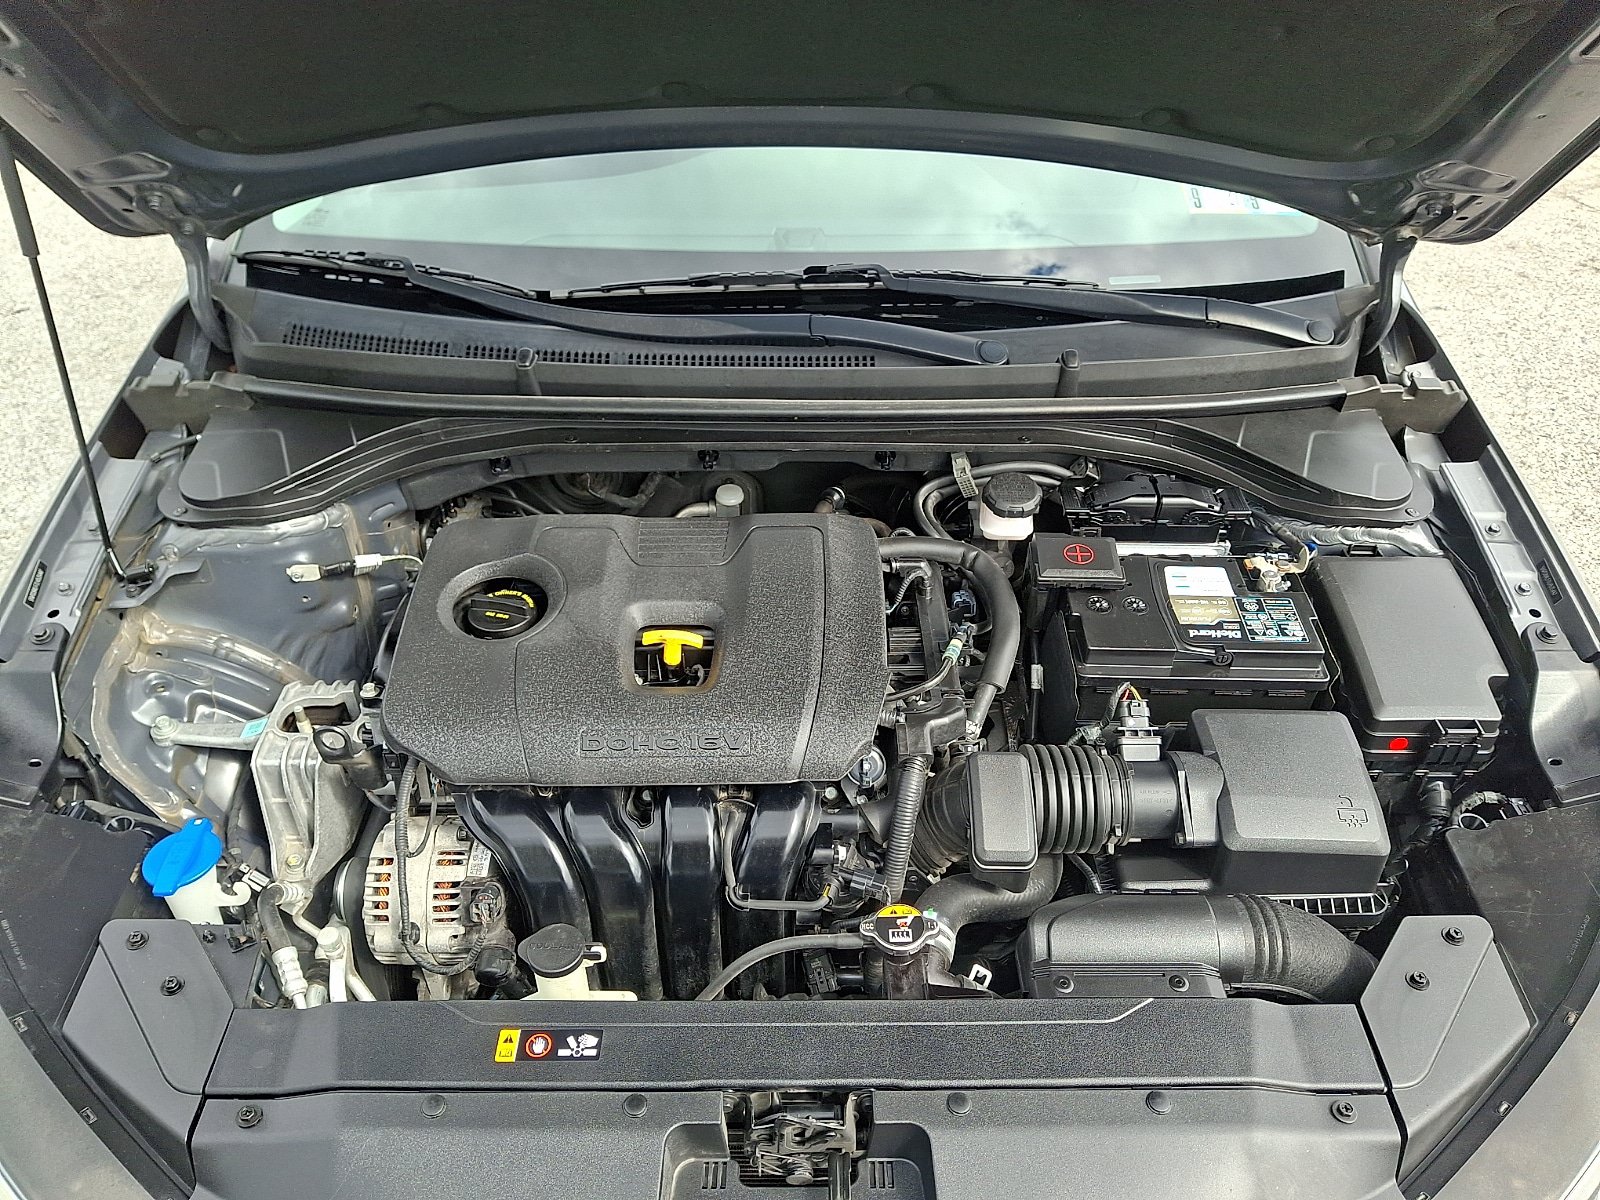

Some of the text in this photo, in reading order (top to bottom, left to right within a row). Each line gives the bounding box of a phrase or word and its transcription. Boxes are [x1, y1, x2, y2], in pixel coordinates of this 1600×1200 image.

[1189, 629, 1242, 638] DieHard
[581, 733, 747, 751] DOHC 16V
[861, 922, 875, 930] HCC
[528, 942, 583, 951] COOLANT
